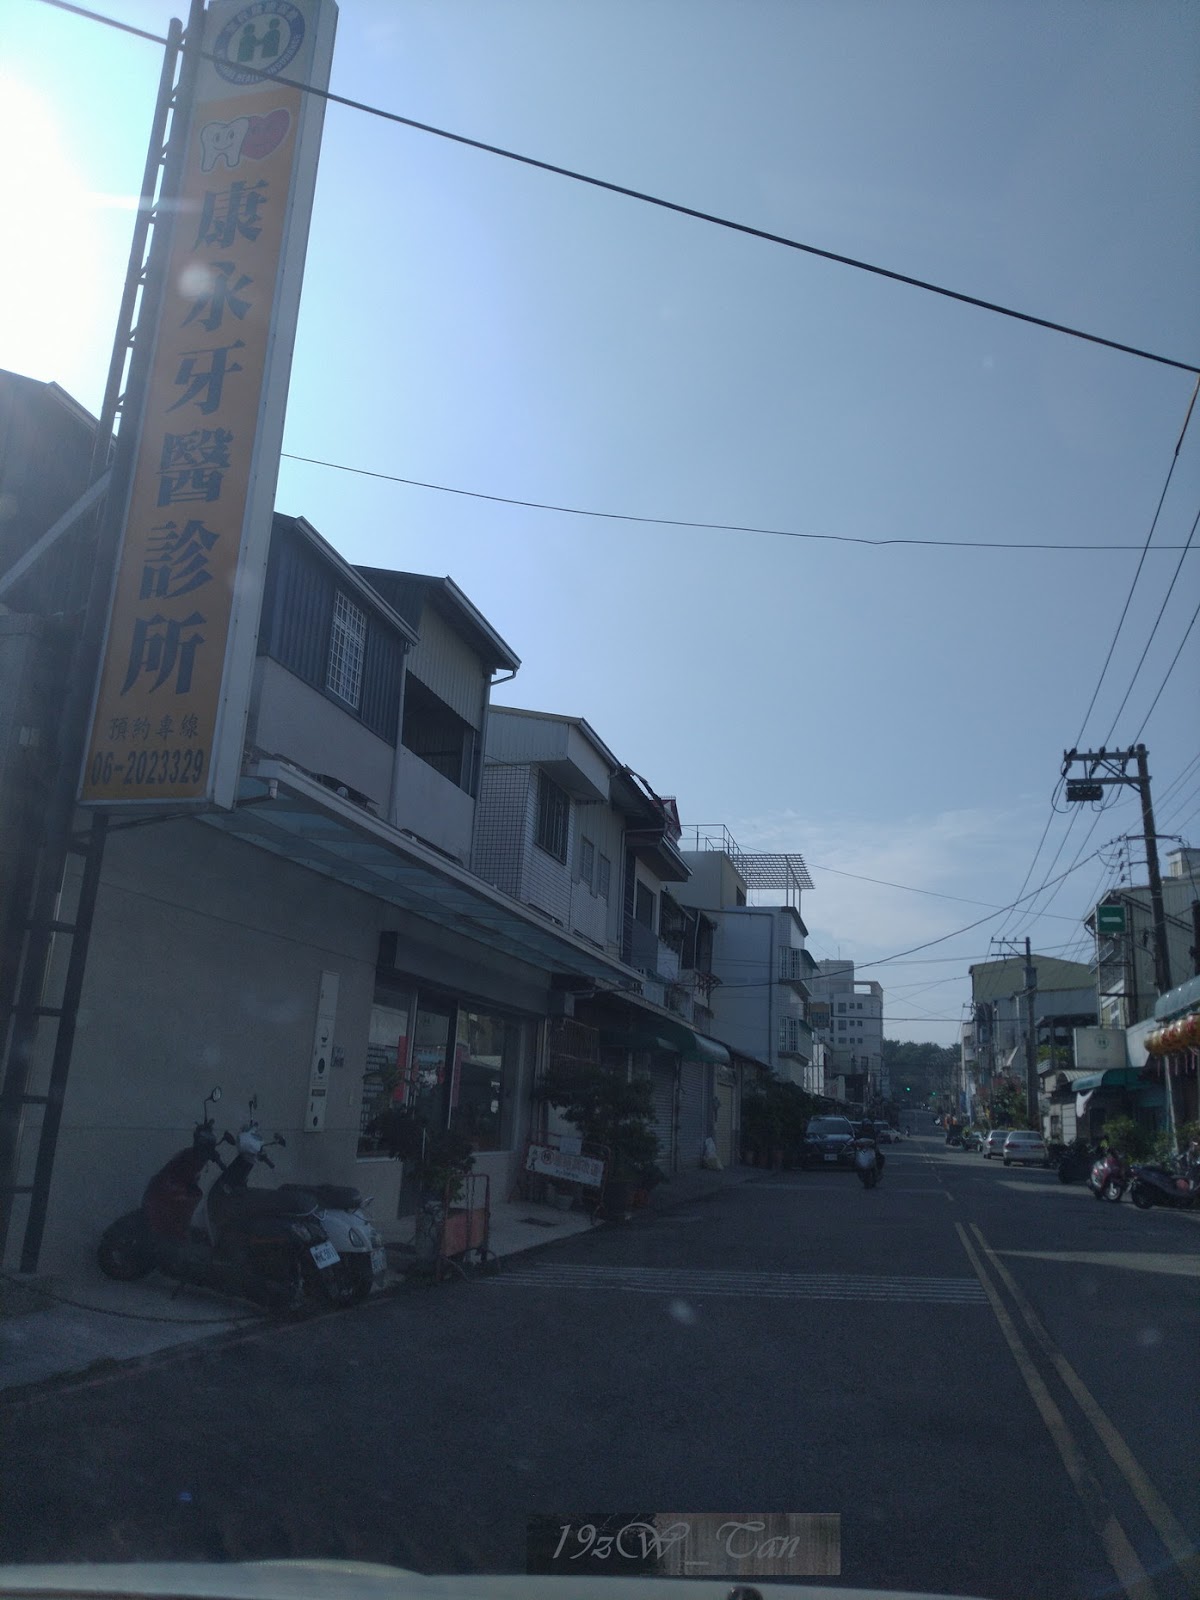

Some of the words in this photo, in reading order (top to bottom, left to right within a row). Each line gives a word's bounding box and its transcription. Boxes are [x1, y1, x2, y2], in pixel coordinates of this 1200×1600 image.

[120, 180, 269, 696] 康永牙醫診所
[109, 713, 199, 740] 預約專線
[91, 748, 204, 786] 06-2023329
